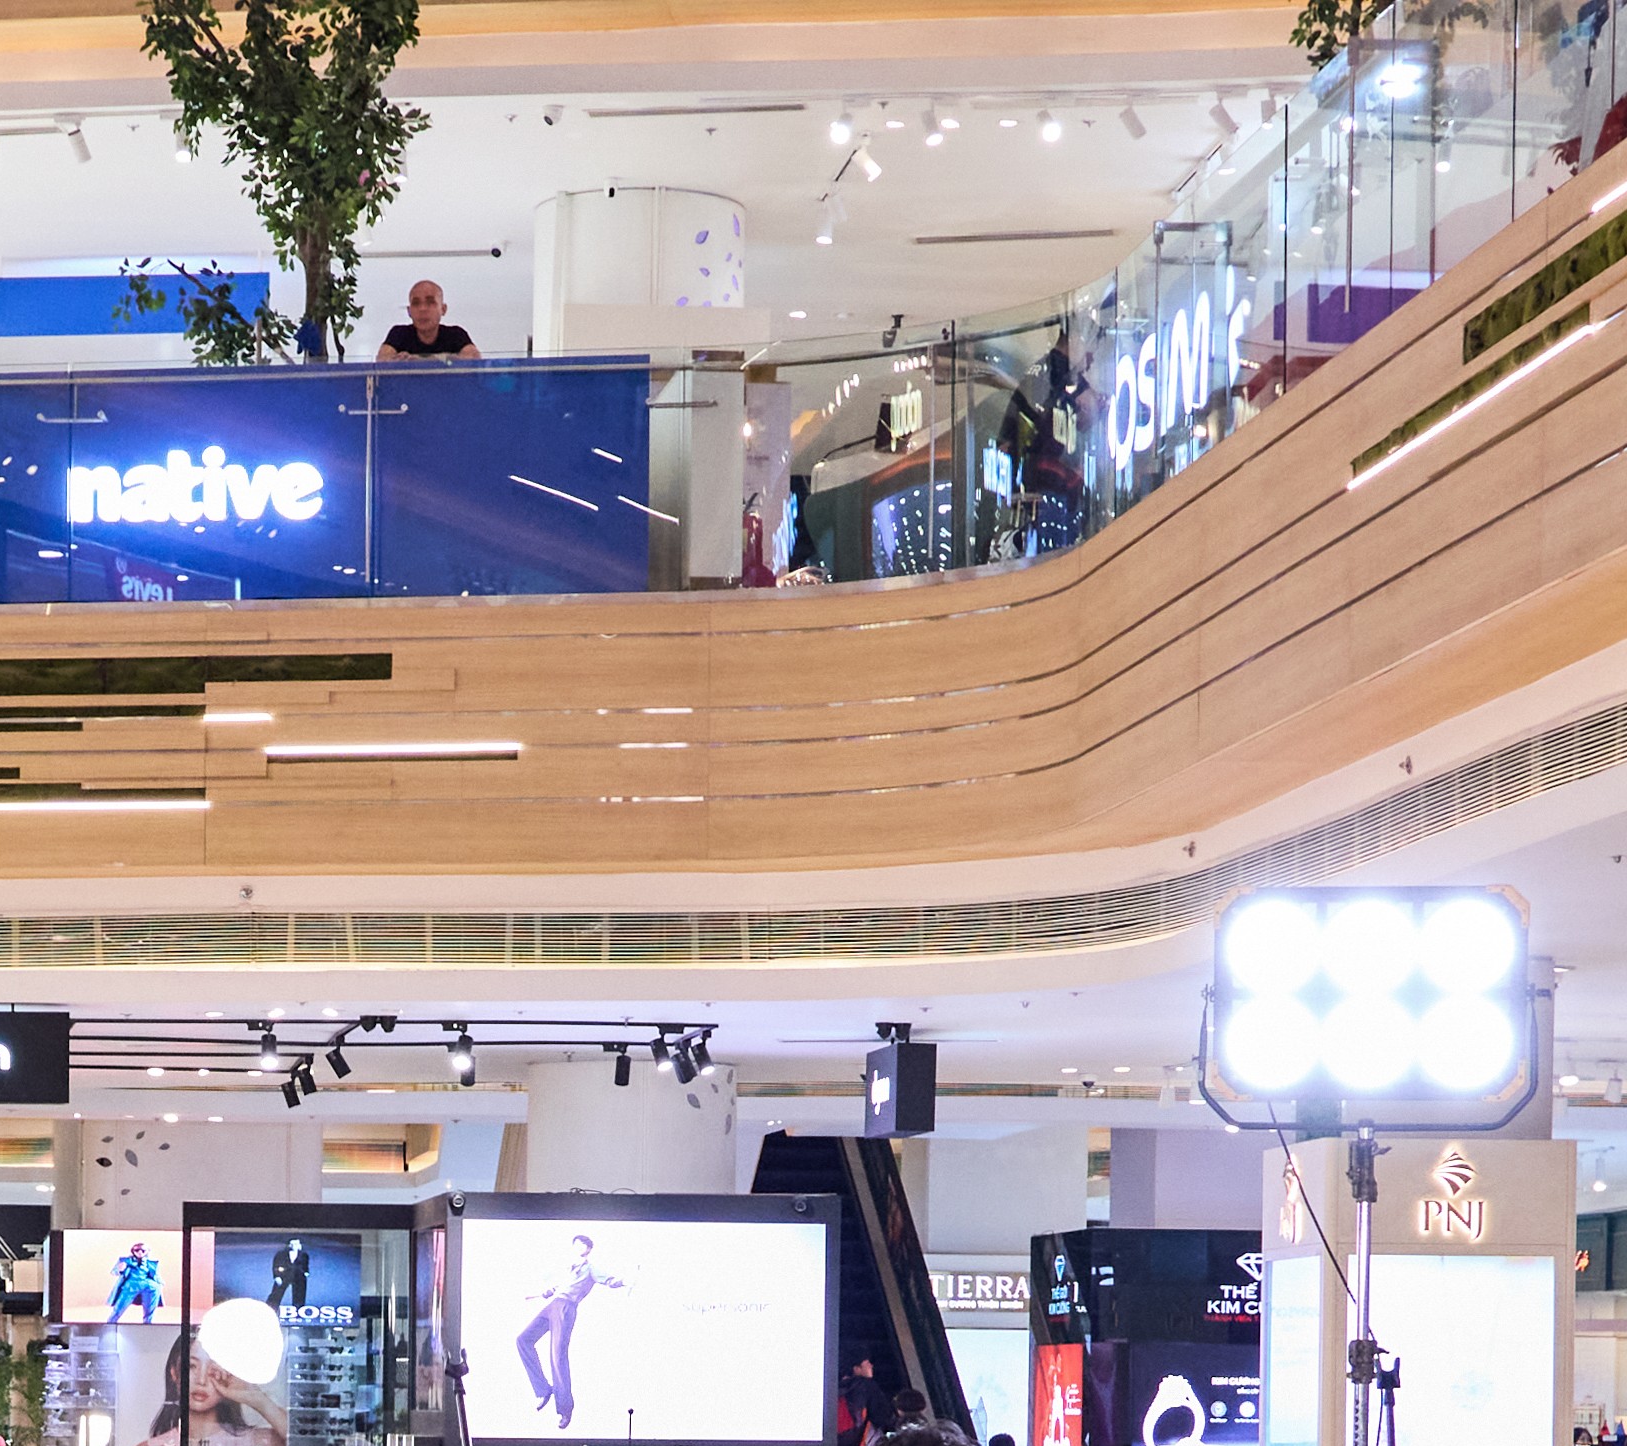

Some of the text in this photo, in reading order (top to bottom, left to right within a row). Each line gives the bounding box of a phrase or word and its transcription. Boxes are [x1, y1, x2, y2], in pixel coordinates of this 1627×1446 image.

[69, 446, 324, 523] native
[1424, 1200, 1485, 1240] PNJ
[930, 1275, 1031, 1298] TIERRA
[1220, 1282, 1258, 1300] THẾ
[279, 1305, 353, 1320] BOSS
[1207, 1301, 1240, 1314] KIM
